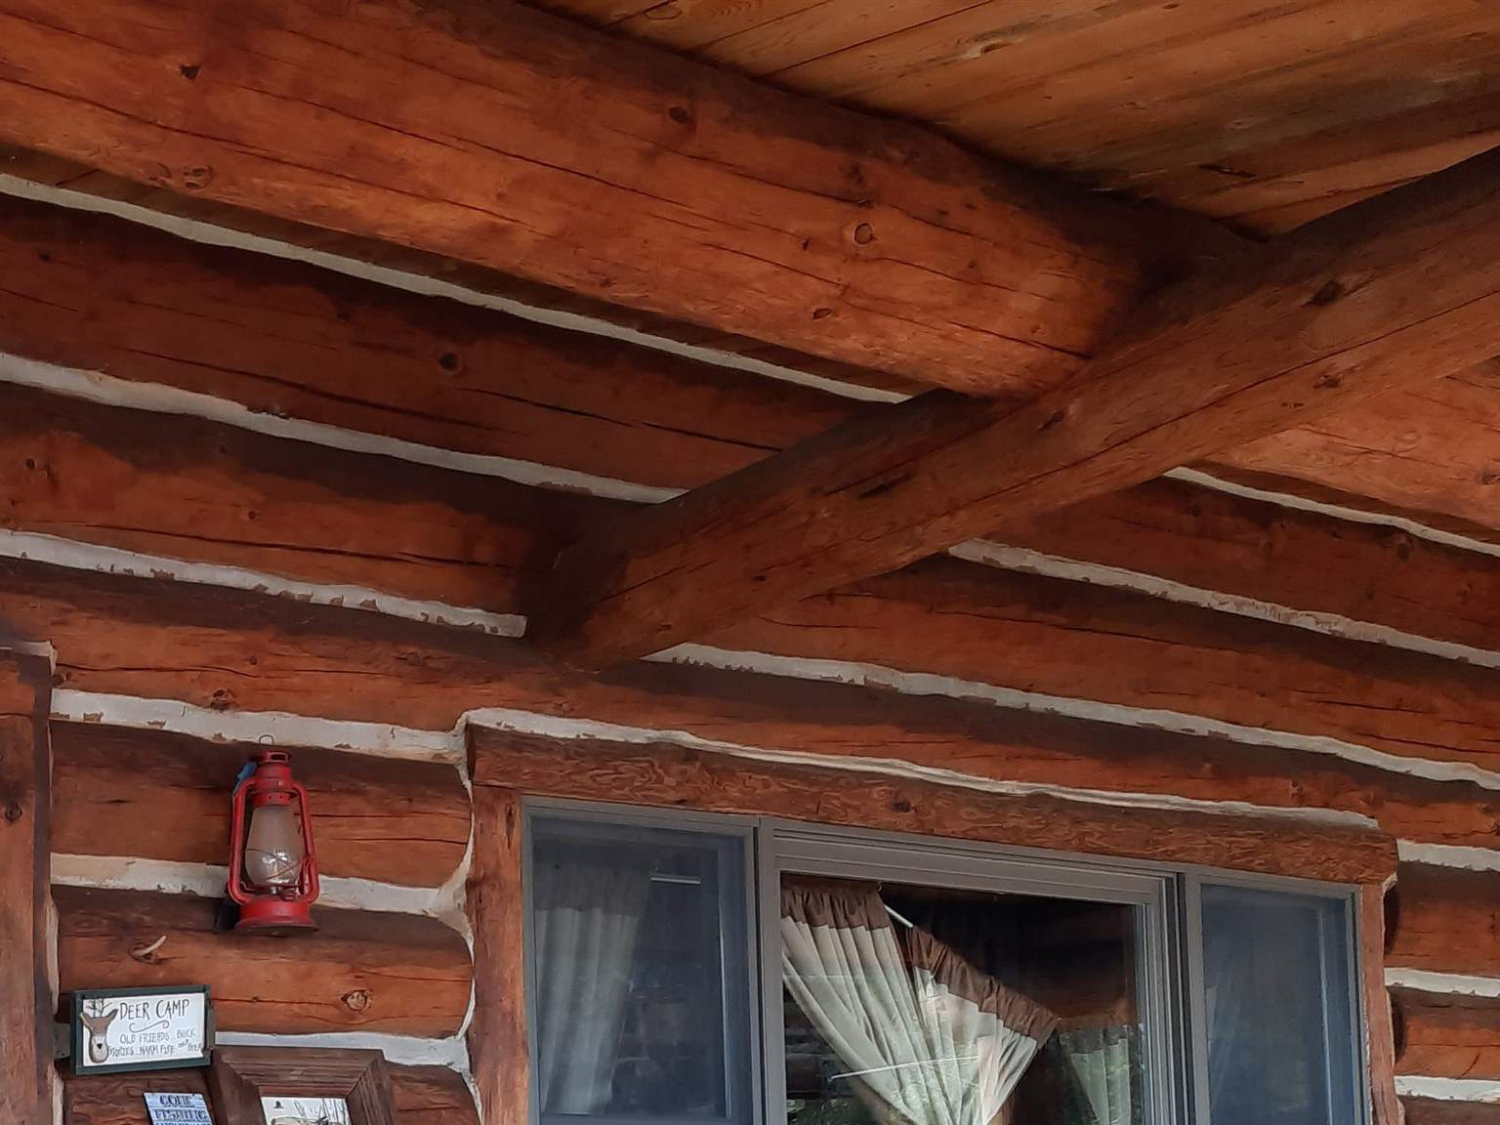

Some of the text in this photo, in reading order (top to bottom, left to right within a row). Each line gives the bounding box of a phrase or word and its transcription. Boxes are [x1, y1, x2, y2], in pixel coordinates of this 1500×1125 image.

[120, 999, 190, 1021] DEER CAMP
[120, 1034, 136, 1045] OLD
[160, 1095, 193, 1107] GONE
[154, 1108, 207, 1120] FISHING
